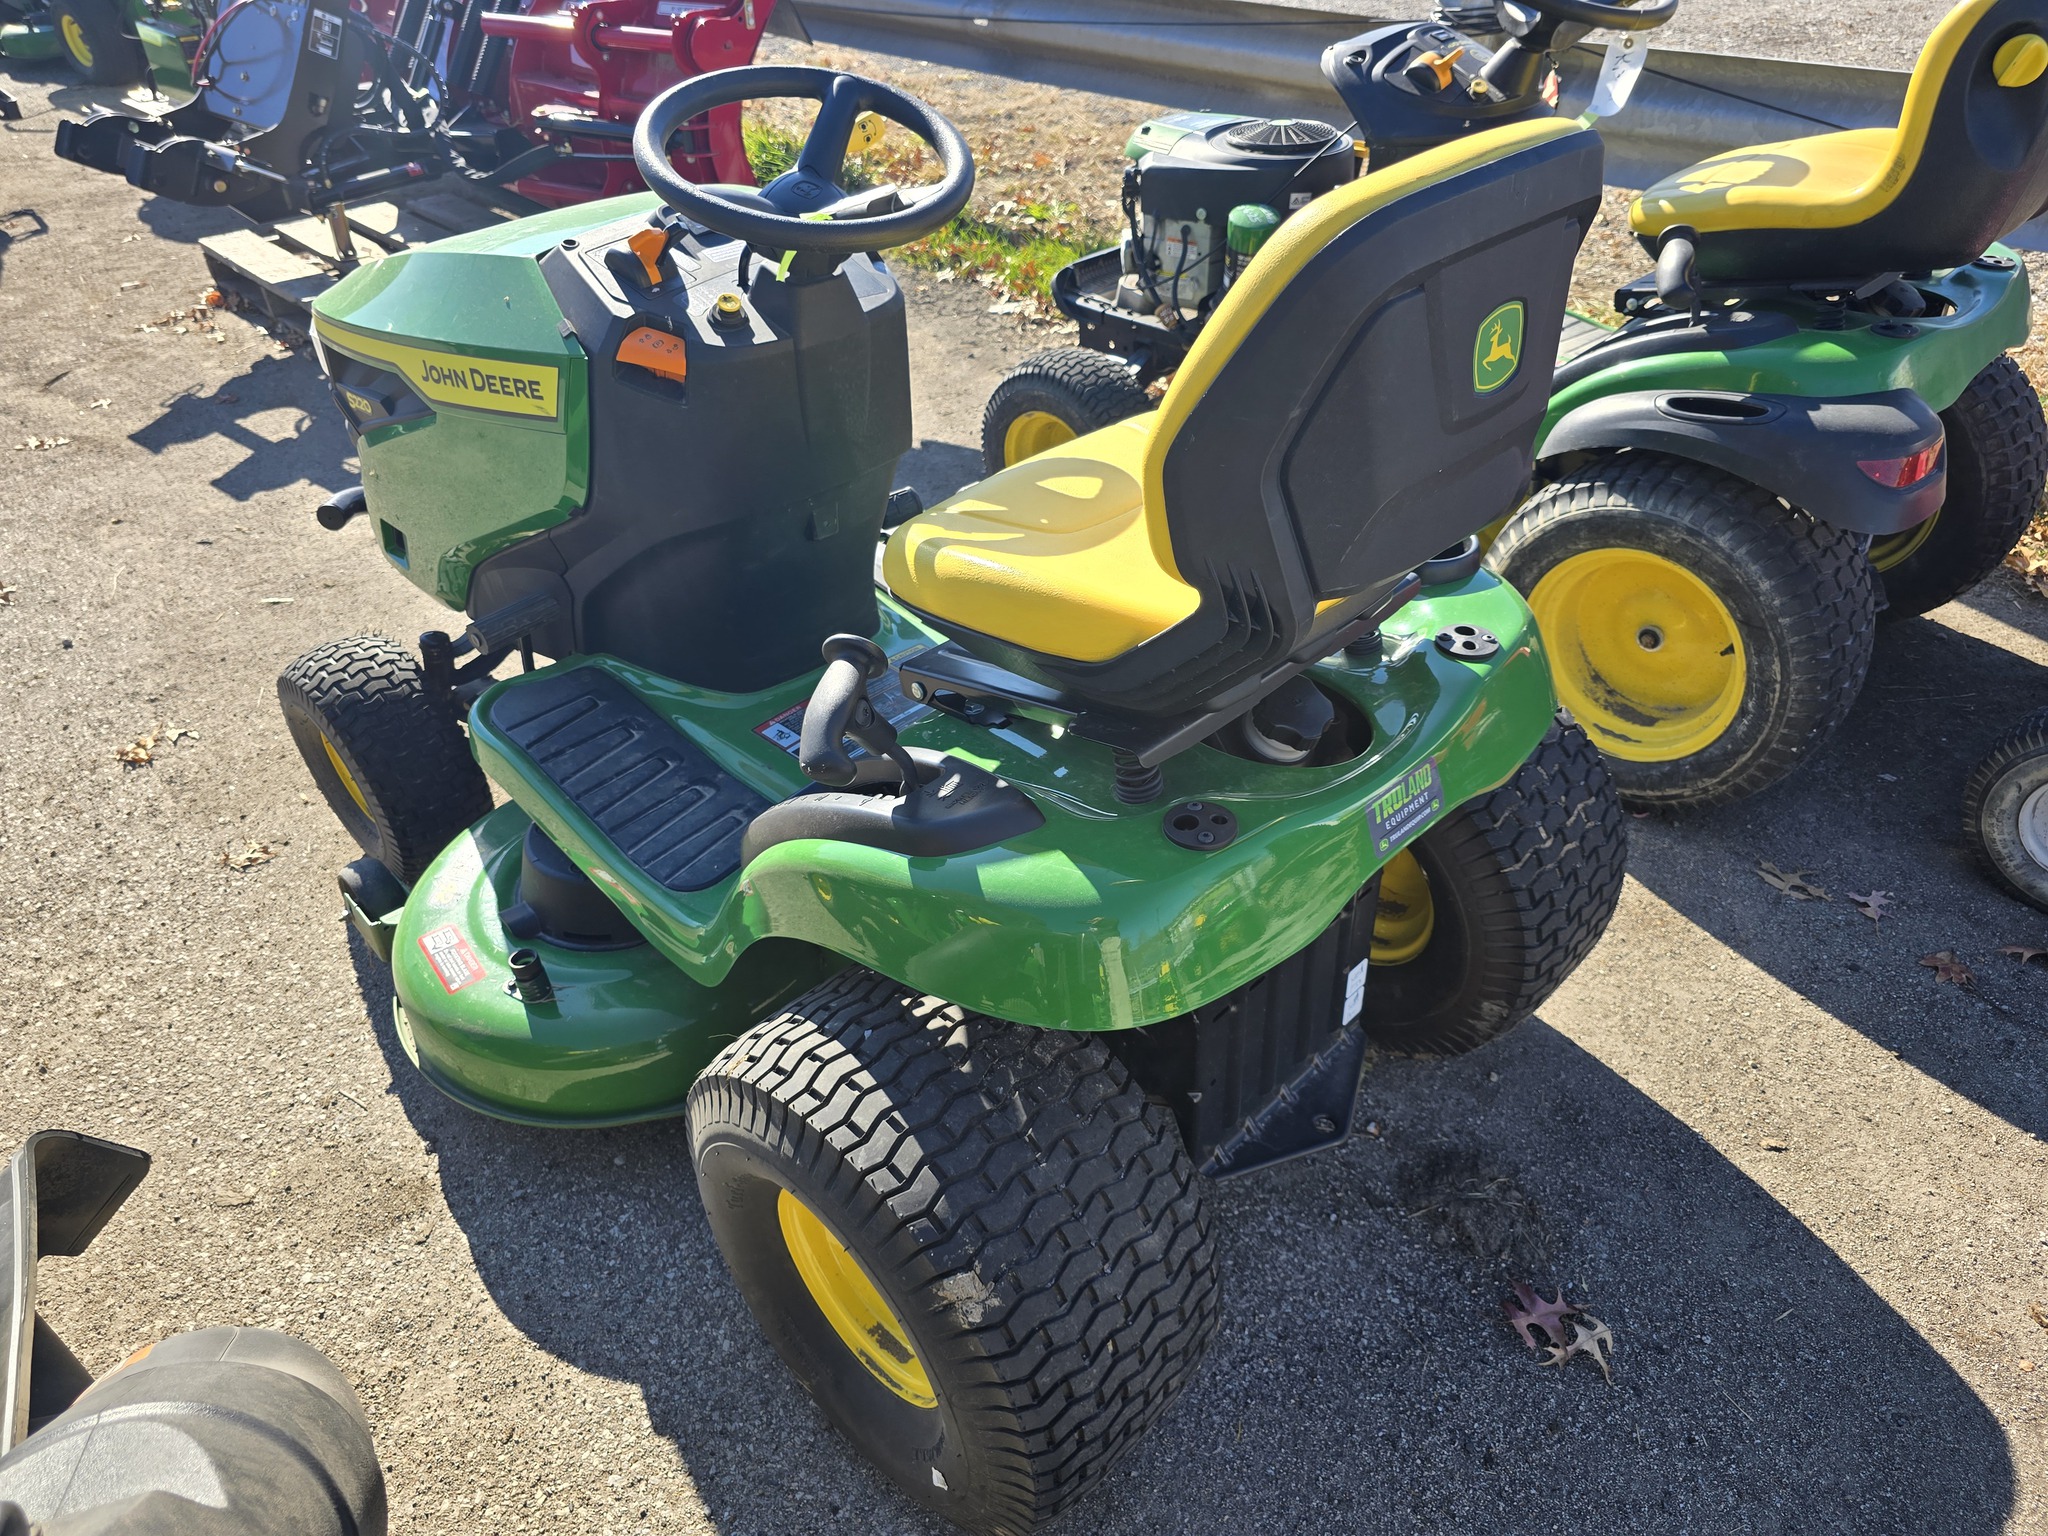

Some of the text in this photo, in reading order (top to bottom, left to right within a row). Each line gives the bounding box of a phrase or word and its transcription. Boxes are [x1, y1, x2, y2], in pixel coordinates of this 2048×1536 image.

[421, 359, 544, 401] JOHN DEERE
[1372, 763, 1432, 824] TRULAND
[1385, 791, 1429, 830] EQUIPMENT
